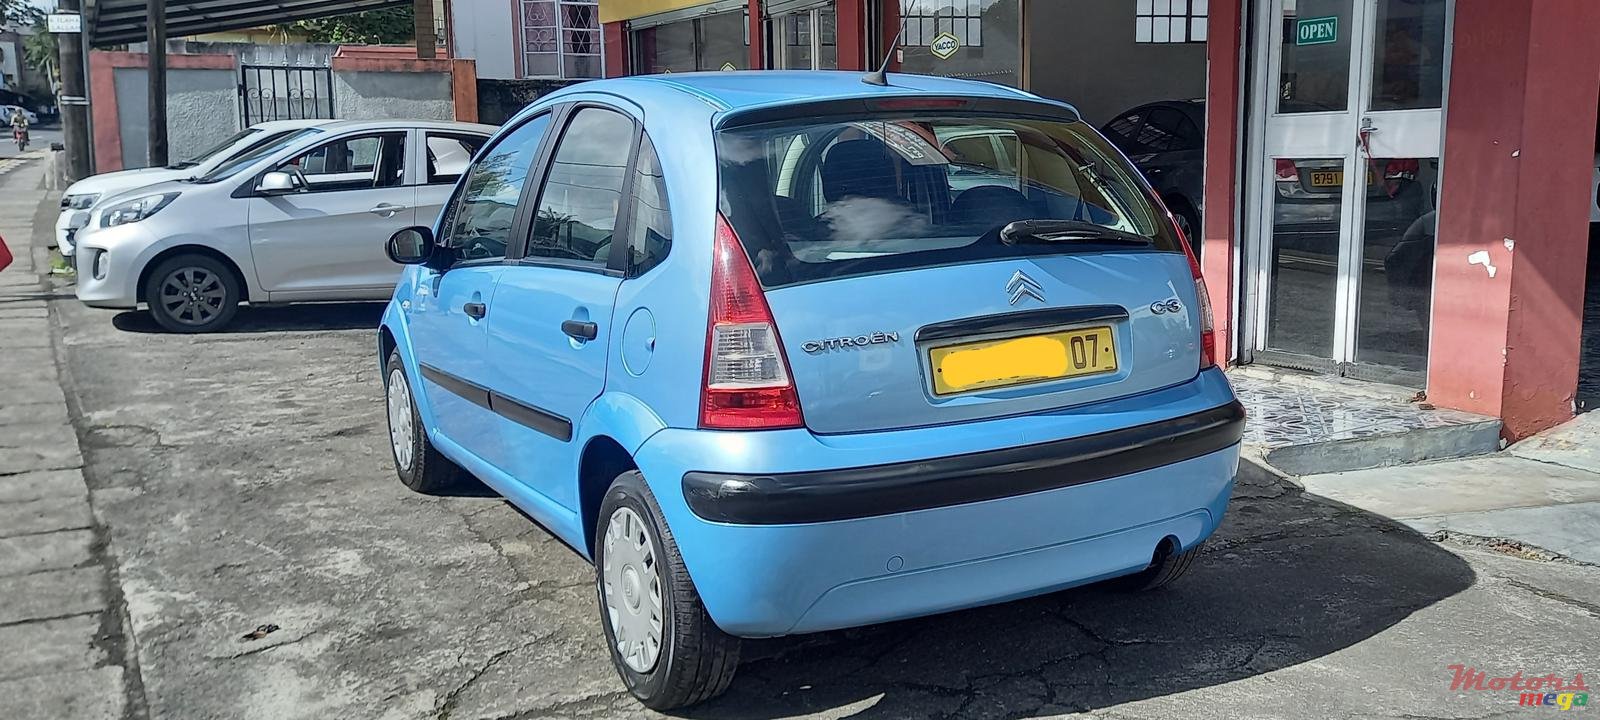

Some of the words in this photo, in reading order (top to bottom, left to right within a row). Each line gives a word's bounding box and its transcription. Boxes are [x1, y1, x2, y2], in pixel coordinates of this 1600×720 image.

[1301, 22, 1334, 40] OPEN
[935, 41, 956, 51] YACCO
[1313, 173, 1338, 185] 8791
[1070, 334, 1098, 369] 07
